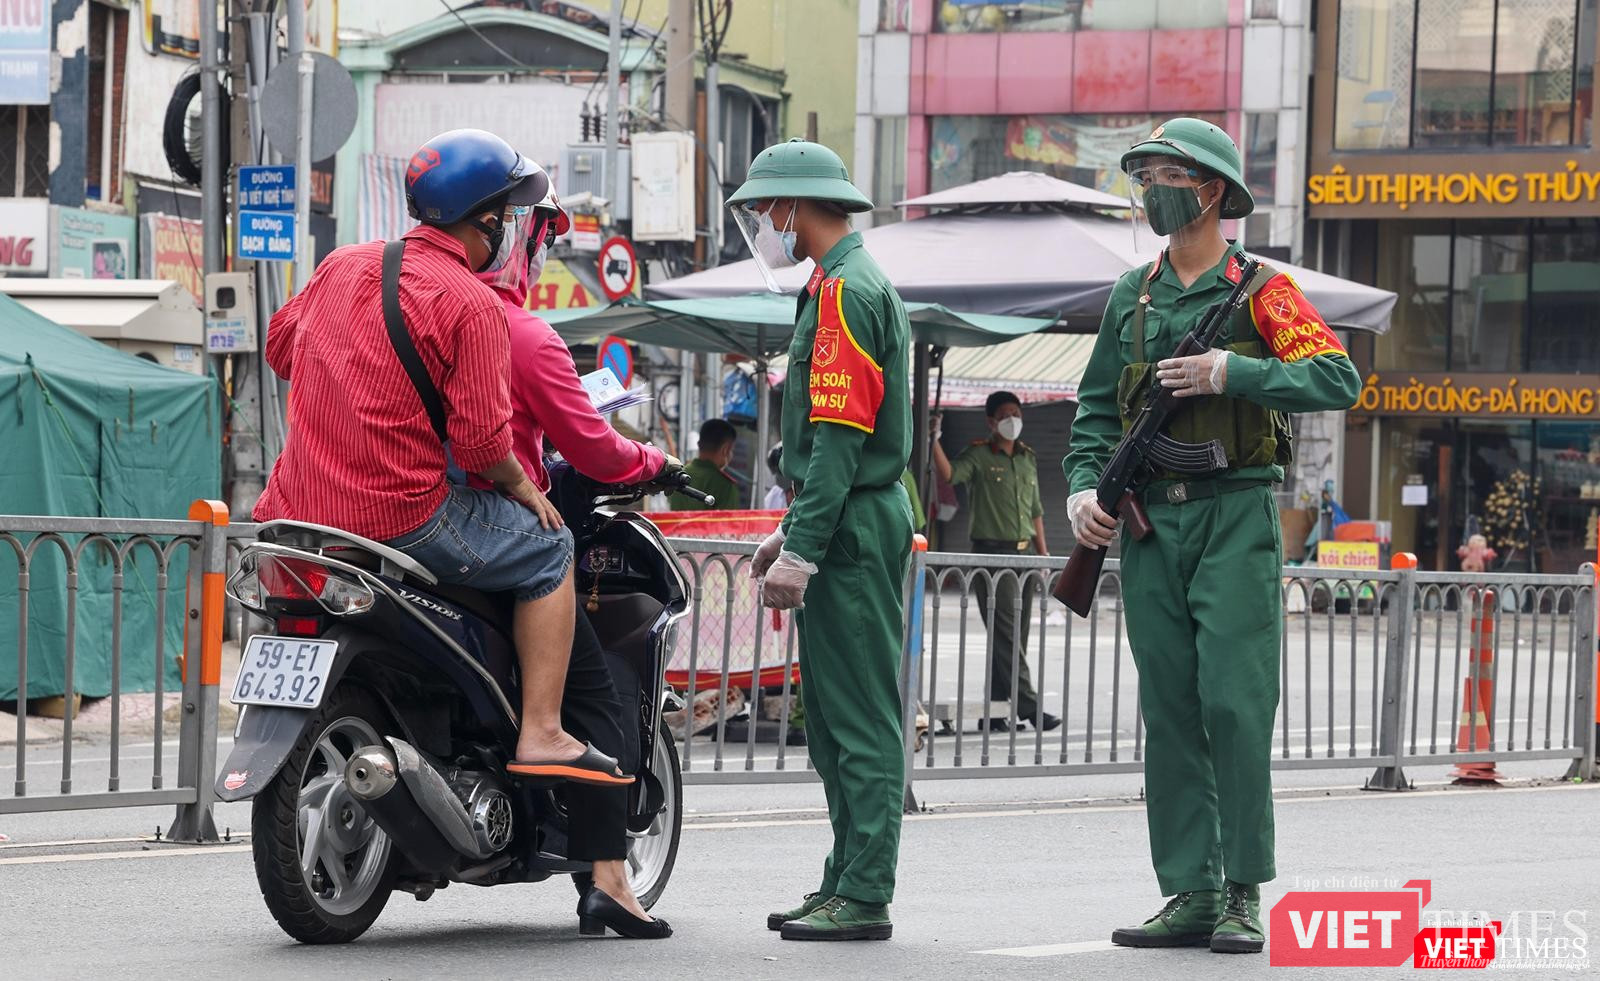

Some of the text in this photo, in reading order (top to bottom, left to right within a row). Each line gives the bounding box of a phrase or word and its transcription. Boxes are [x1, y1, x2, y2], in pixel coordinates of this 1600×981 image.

[1308, 159, 1600, 211] SIÊU THỊ PHONG THỦY
[242, 235, 264, 255] BẠCH
[822, 369, 852, 389] SOÁT
[828, 393, 848, 412] SỰ
[1381, 376, 1424, 411] THỜ
[1520, 386, 1594, 415] PHONG
[398, 587, 463, 621] VISION
[256, 641, 320, 671] 59-E1
[238, 672, 321, 703] 643.92
